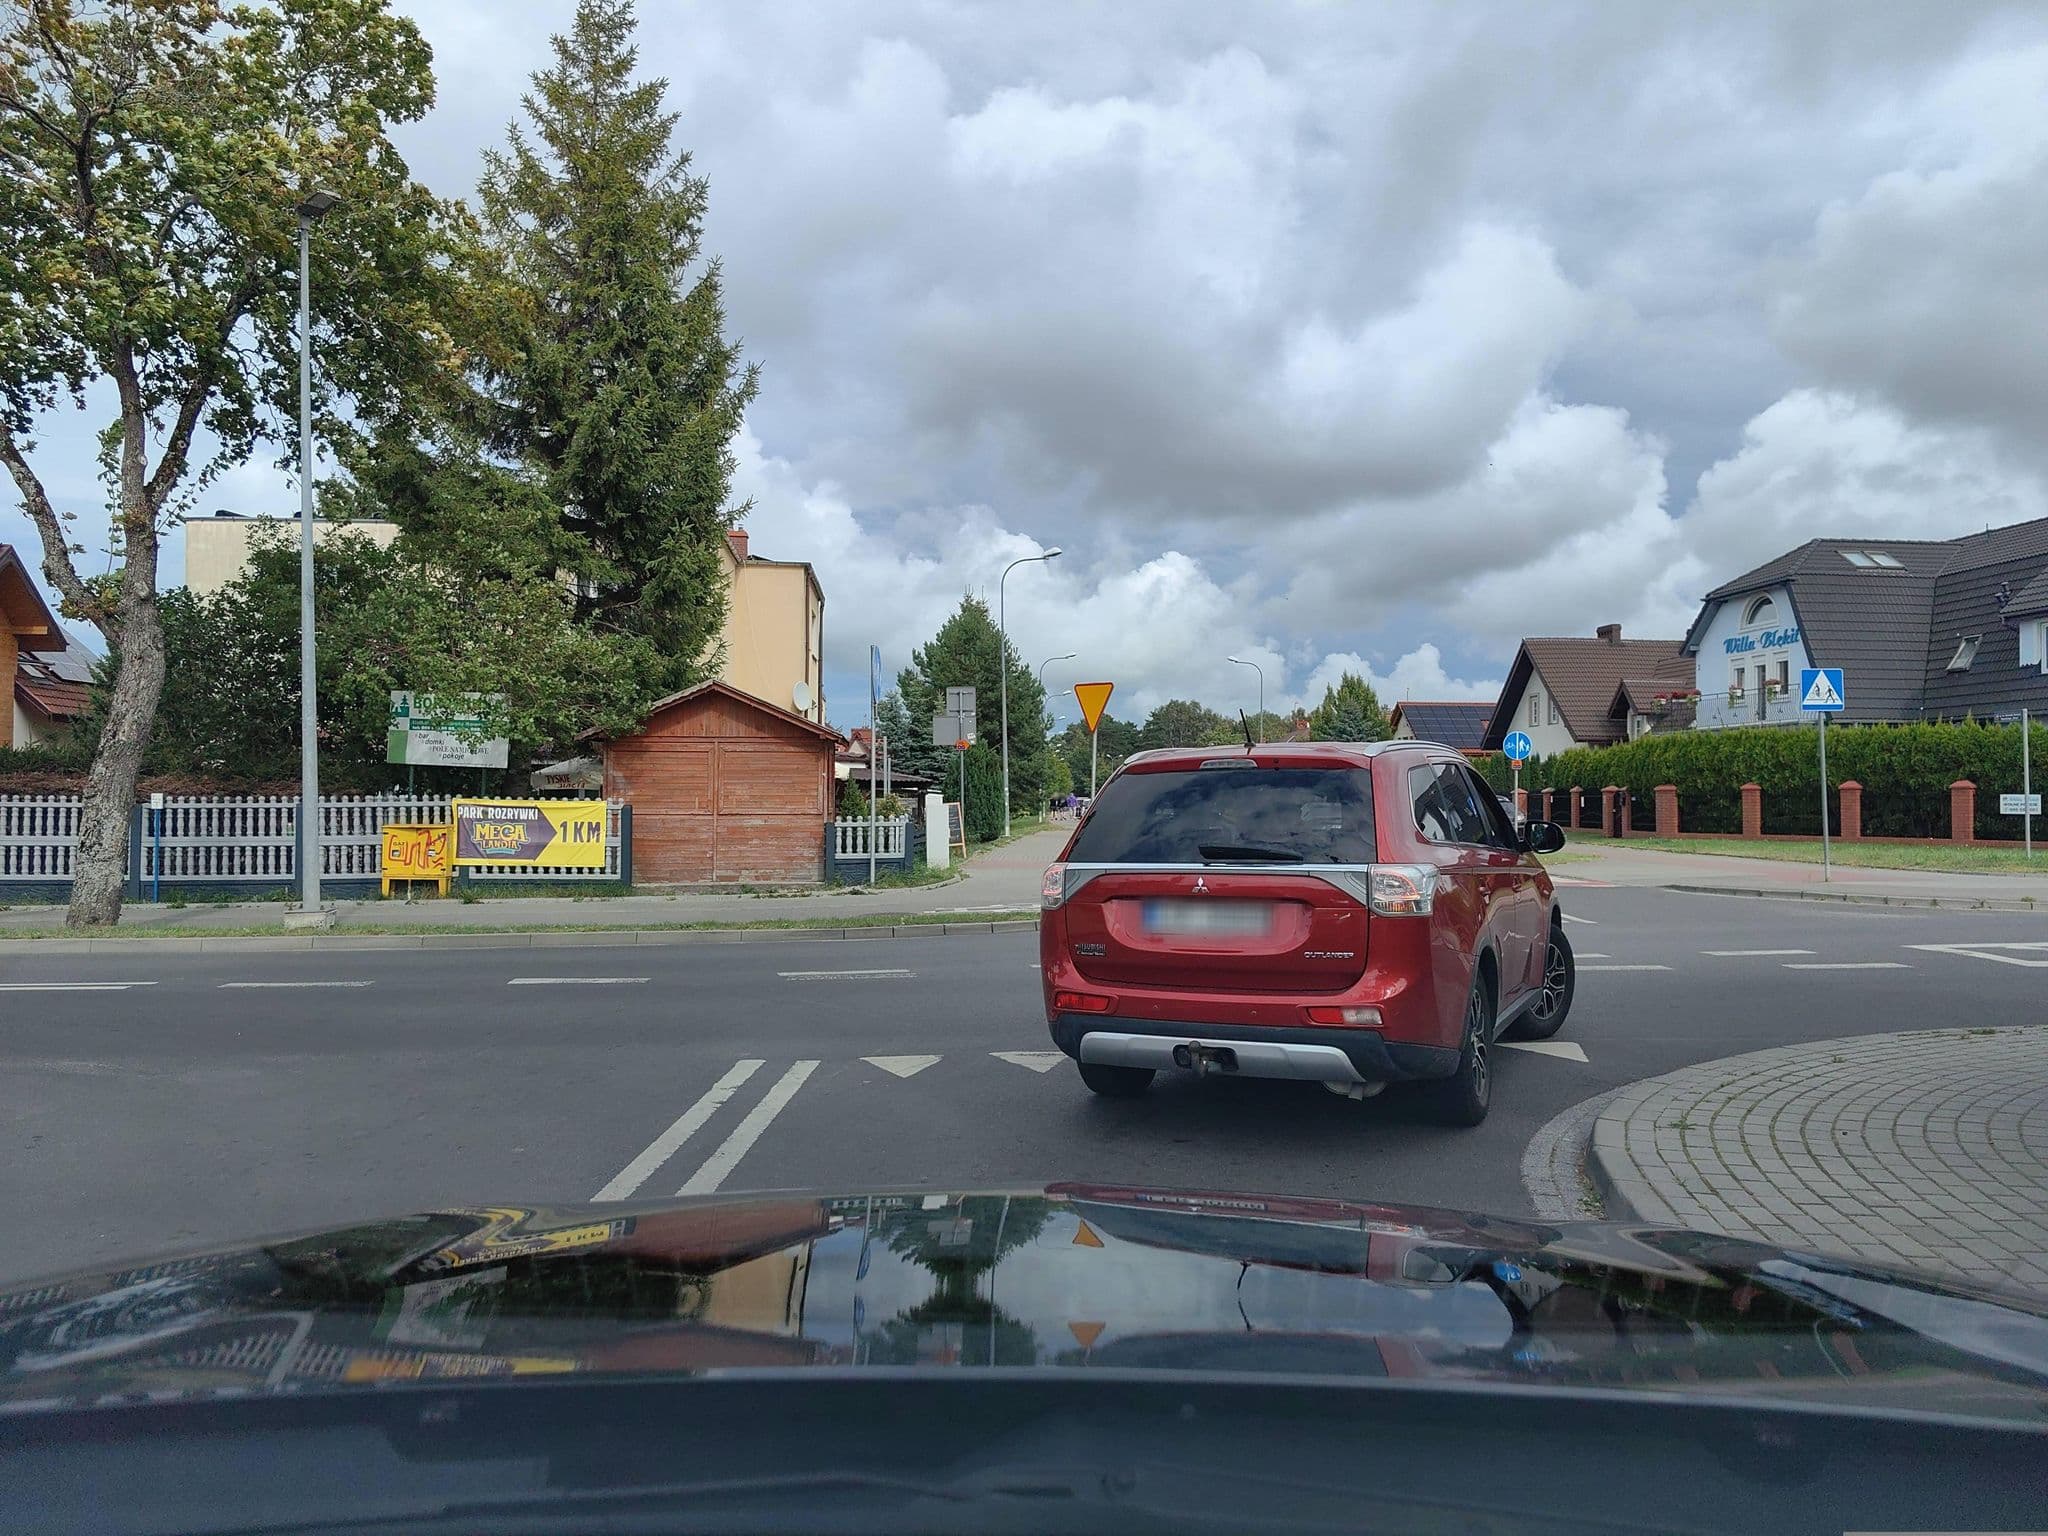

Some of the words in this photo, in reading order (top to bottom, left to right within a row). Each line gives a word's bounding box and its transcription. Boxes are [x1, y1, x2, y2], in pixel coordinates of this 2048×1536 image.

[1723, 635, 1756, 654] Willa
[425, 739, 446, 747] domki
[545, 774, 570, 784] TYSKIE
[457, 806, 483, 819] PARK
[488, 807, 538, 820] ROZRYWKI
[473, 823, 529, 842] MEGA
[560, 821, 568, 843] 1
[573, 821, 601, 843] KM
[482, 840, 518, 850] LANDIA
[1304, 951, 1354, 959] OUTLANDER
